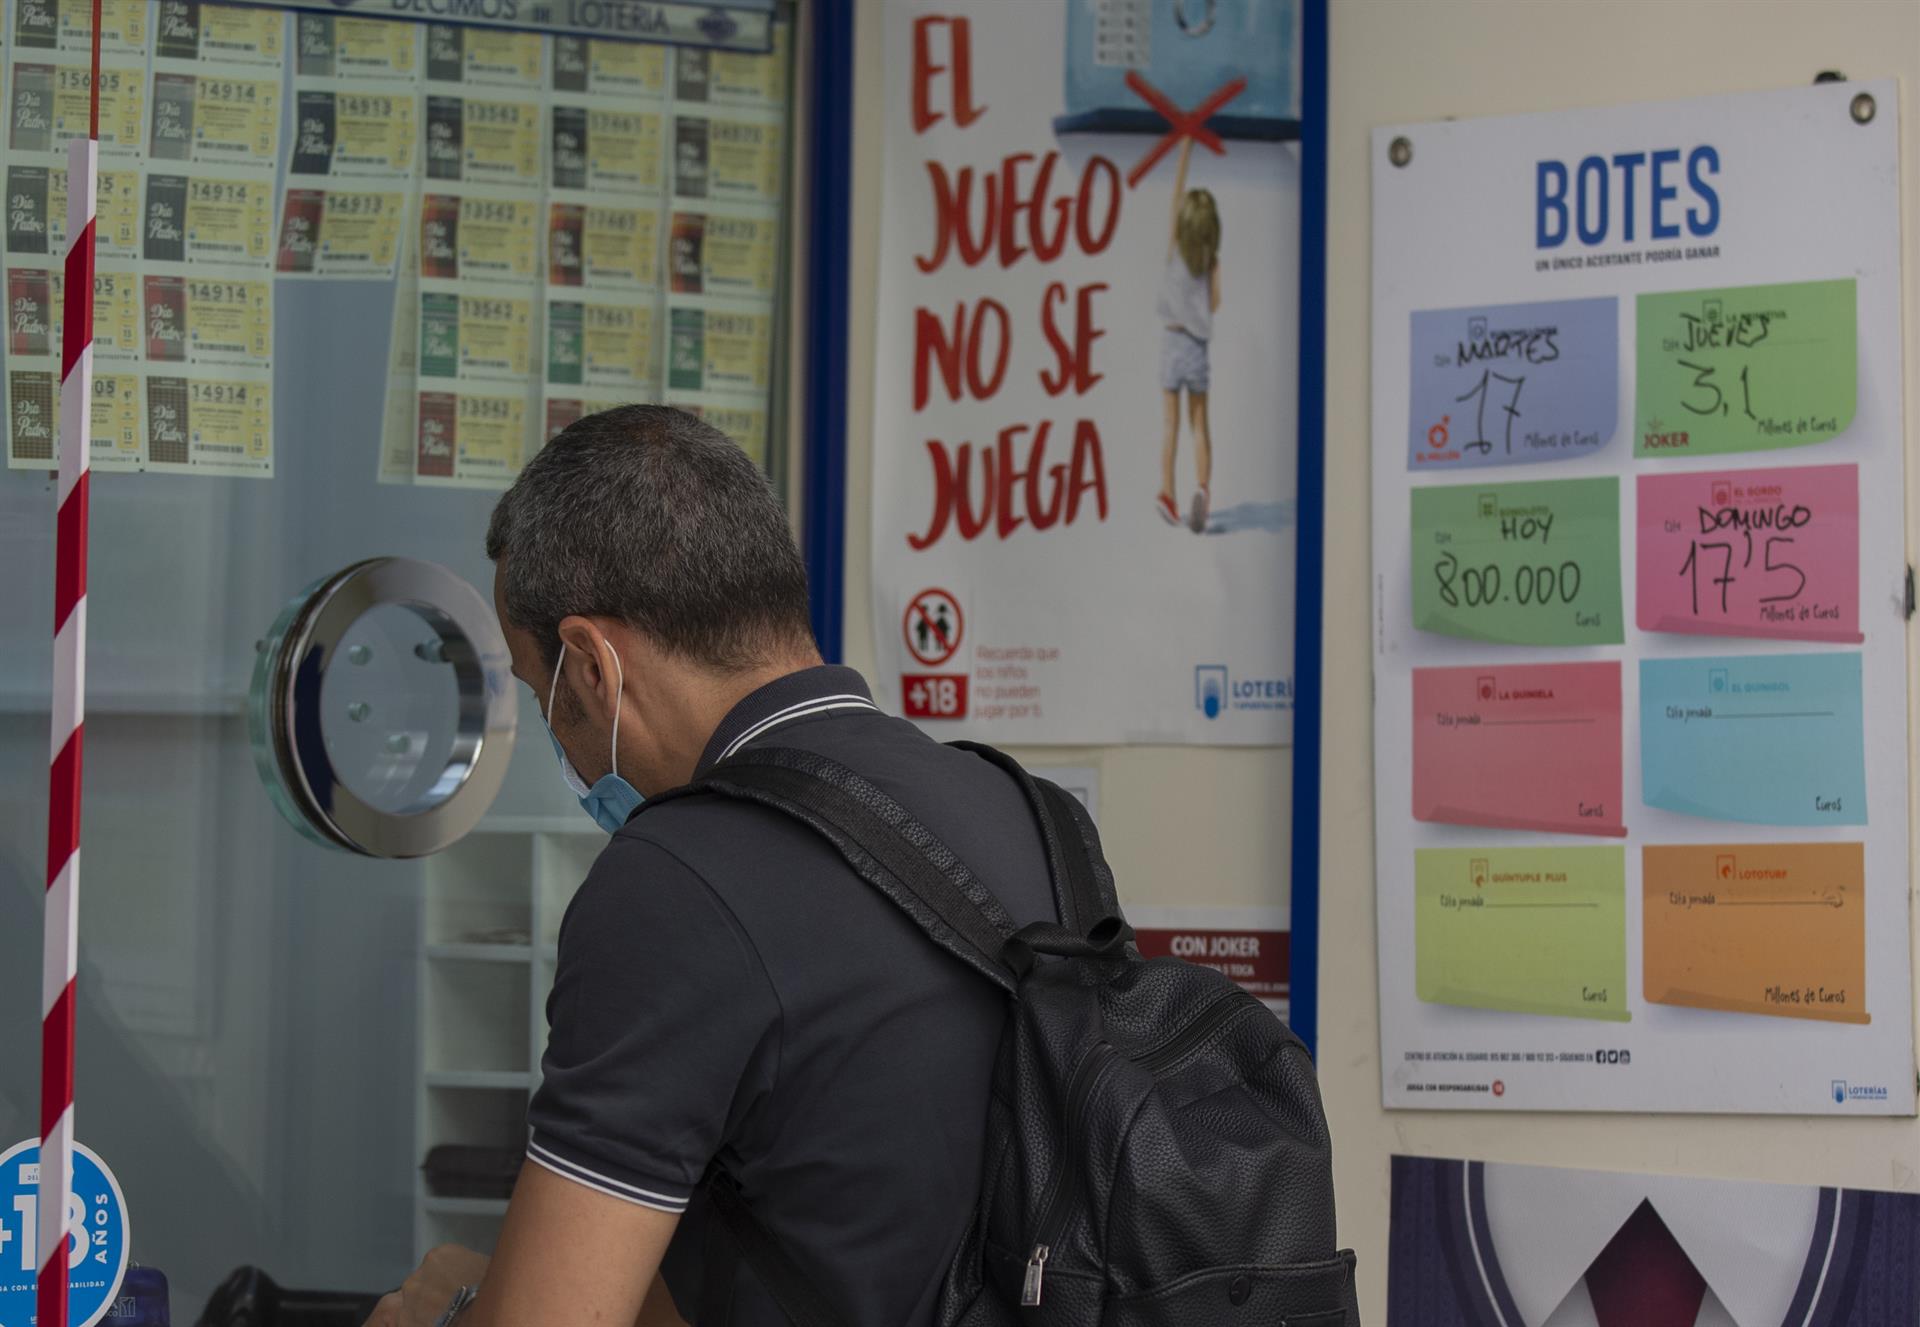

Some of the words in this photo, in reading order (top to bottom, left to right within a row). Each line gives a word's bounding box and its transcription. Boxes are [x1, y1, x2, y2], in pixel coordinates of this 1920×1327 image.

[911, 14, 988, 135] EL
[200, 82, 256, 100] 14914
[191, 183, 247, 202] 14914
[1536, 144, 1721, 250] BOTES
[914, 151, 1122, 274] JUEGO
[1535, 257, 1550, 271] UN
[1586, 251, 1642, 268] ACERTANTE
[1685, 246, 1721, 261] GANAR
[189, 284, 248, 302] 14914
[912, 297, 1012, 413] NO
[1039, 281, 1110, 397] SE
[1679, 312, 1770, 352] JUEVES
[1457, 331, 1560, 367] MARTES
[192, 384, 247, 402] 14914
[1676, 359, 1757, 421] 3,1
[1455, 368, 1526, 456] 17
[1643, 432, 1690, 449] JOKER
[906, 418, 1109, 552] JUEGA
[1501, 513, 1554, 545] HOY
[1697, 504, 1812, 534] DOMINGO
[1434, 551, 1581, 608] 800.000
[1760, 604, 1796, 622] Millones
[909, 678, 959, 714] +18
[1545, 872, 1568, 883] PLUS
[1169, 935, 1208, 958] CON
[1209, 936, 1261, 959] JOKER
[1764, 984, 1801, 1004] Millones
[1804, 986, 1815, 1004] de
[92, 1193, 108, 1264] AÑOS
[11, 1284, 28, 1293] CON
